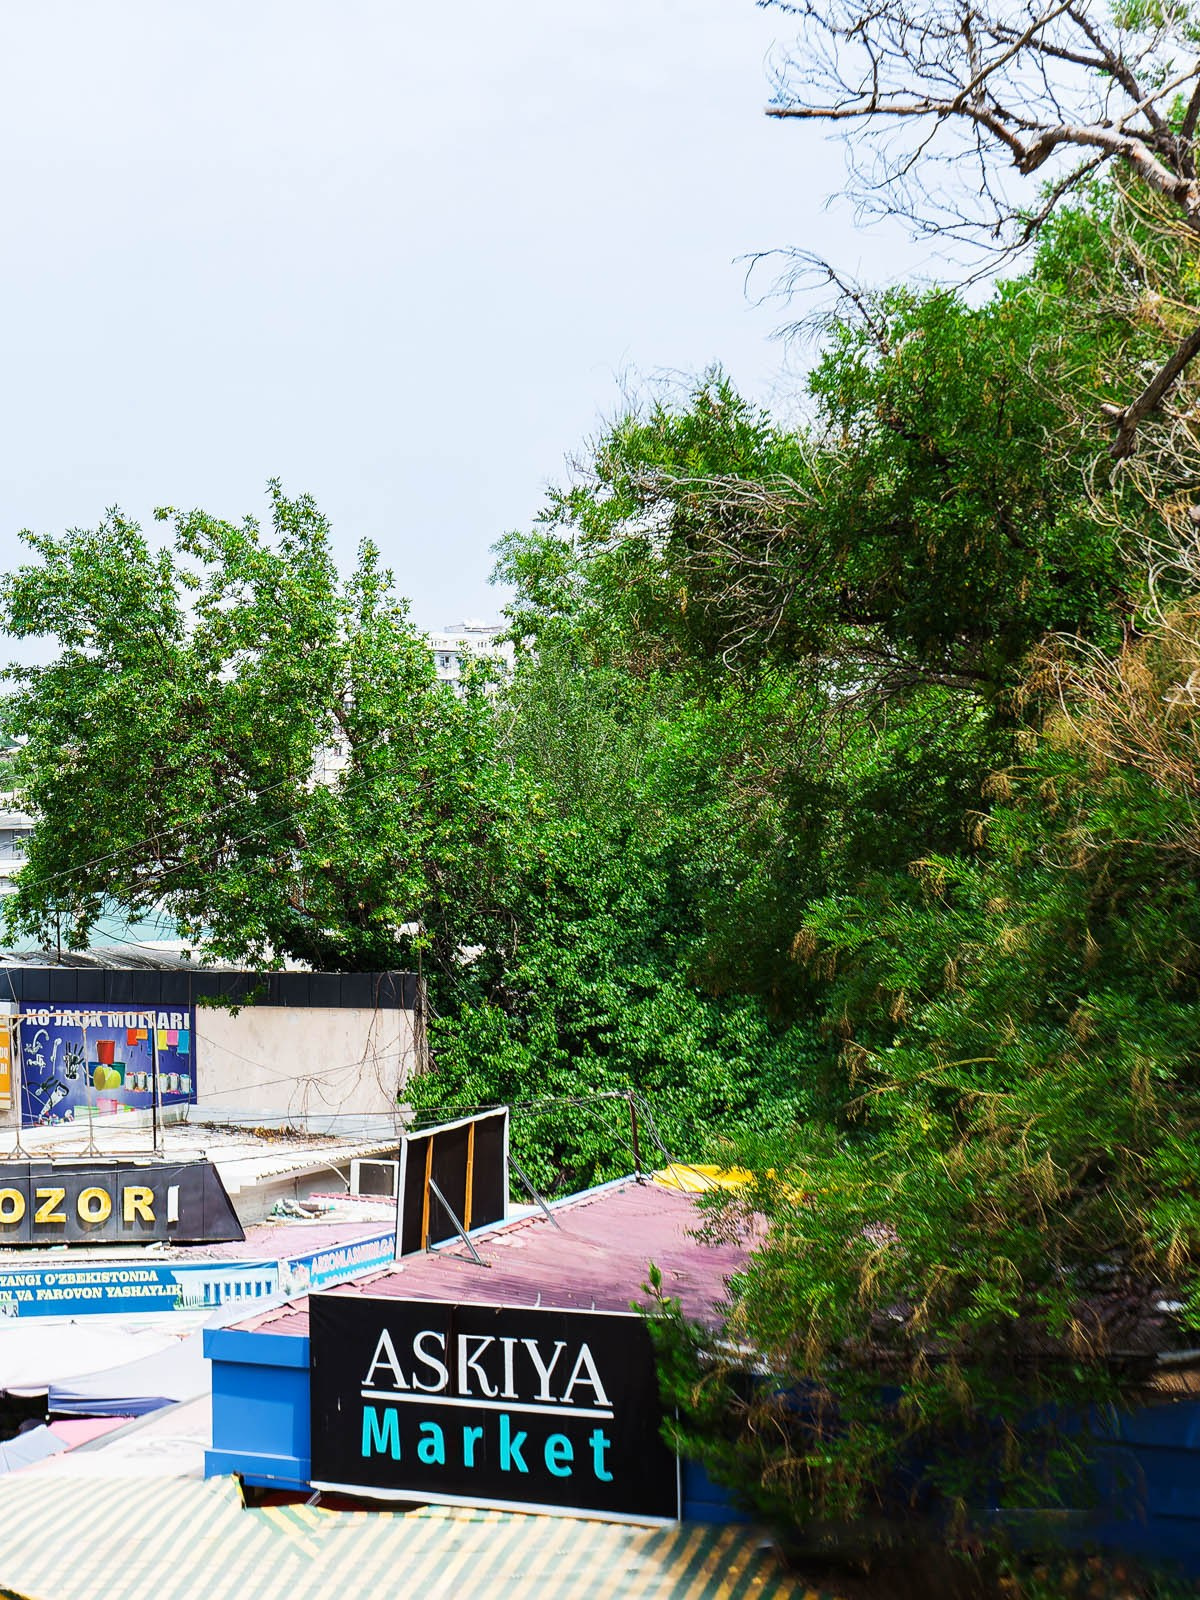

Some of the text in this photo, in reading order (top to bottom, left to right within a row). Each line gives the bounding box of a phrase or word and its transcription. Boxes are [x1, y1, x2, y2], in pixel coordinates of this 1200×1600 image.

[14, 1290, 35, 1302] VA
[35, 1287, 103, 1301] FAROVON
[104, 1284, 183, 1299] YASHAYLIK
[43, 1270, 159, 1286] O'ZBEKISTONDA
[361, 1328, 614, 1407] ASKIYA
[361, 1405, 615, 1483] Market
